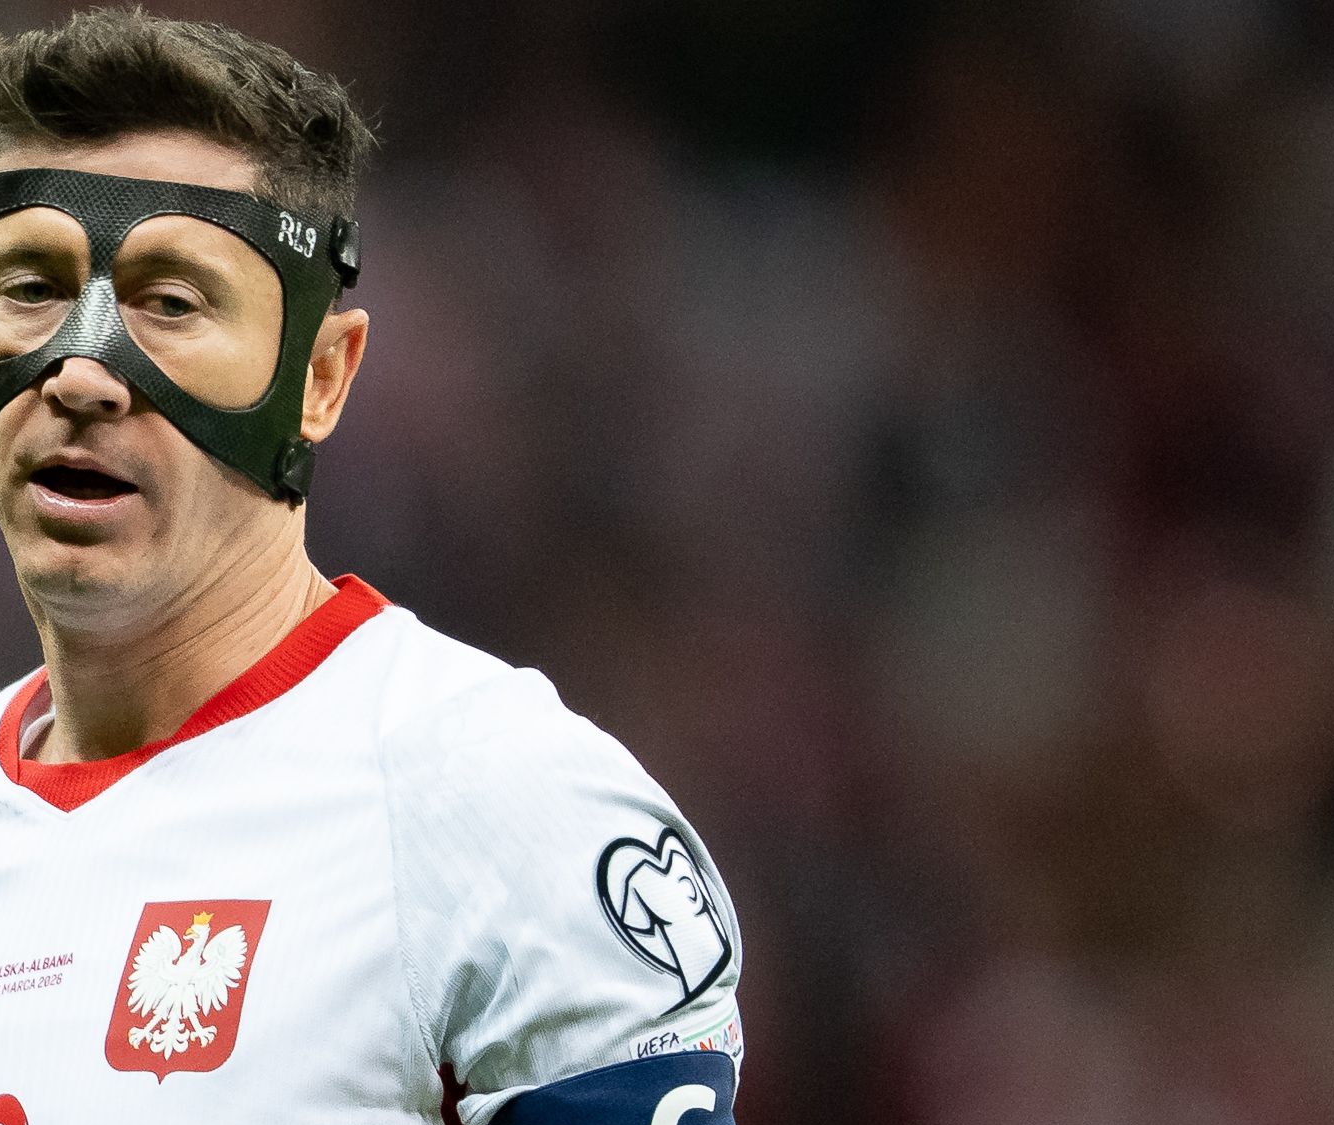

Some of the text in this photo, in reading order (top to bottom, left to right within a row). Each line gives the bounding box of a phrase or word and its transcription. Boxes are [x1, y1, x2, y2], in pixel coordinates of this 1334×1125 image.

[278, 211, 317, 258] RL9
[2, 978, 35, 995] MARCA
[37, 973, 63, 989] 2026
[637, 1032, 680, 1059] UEFA
